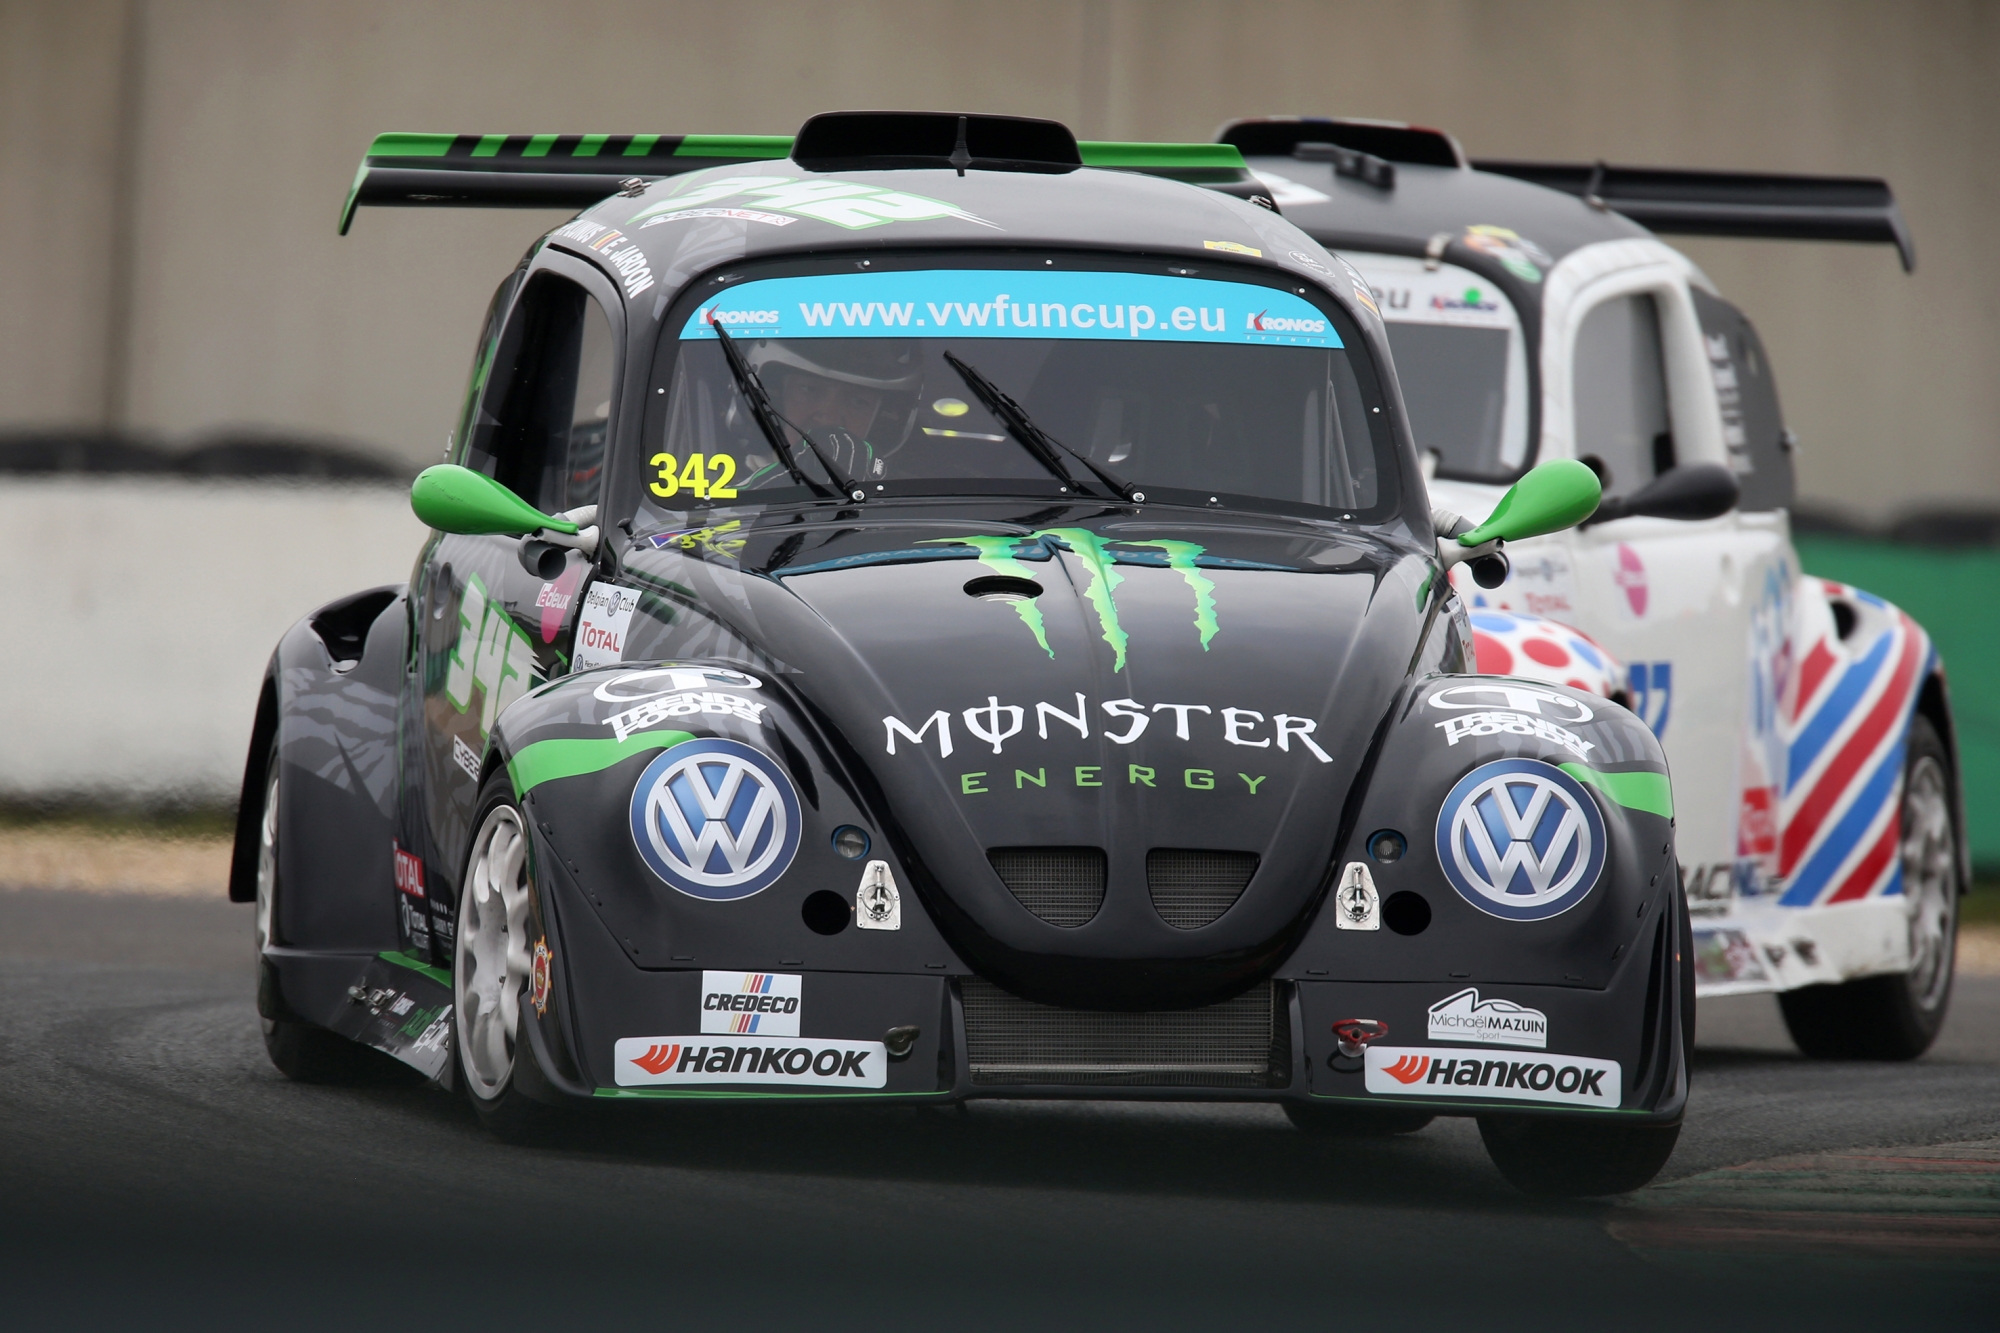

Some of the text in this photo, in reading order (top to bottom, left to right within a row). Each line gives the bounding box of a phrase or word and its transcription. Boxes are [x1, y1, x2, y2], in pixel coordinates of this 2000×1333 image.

[609, 245, 655, 299] JARDON
[699, 303, 779, 326] KRONOS
[799, 294, 1226, 338] www.vwfuncup.eu
[1246, 309, 1325, 333] KRONOS
[649, 453, 738, 499] 342
[619, 597, 634, 612] Club
[582, 621, 620, 653] TOTAL
[602, 692, 767, 731] TRENDY
[615, 703, 762, 743] FOODS
[882, 691, 1333, 763] MONSTER
[1435, 711, 1595, 753] TRENDY
[1447, 722, 1589, 763] FOODS
[961, 764, 1267, 795] ENERGY
[703, 993, 799, 1014] CREDECO
[1476, 1029, 1500, 1041] Sport
